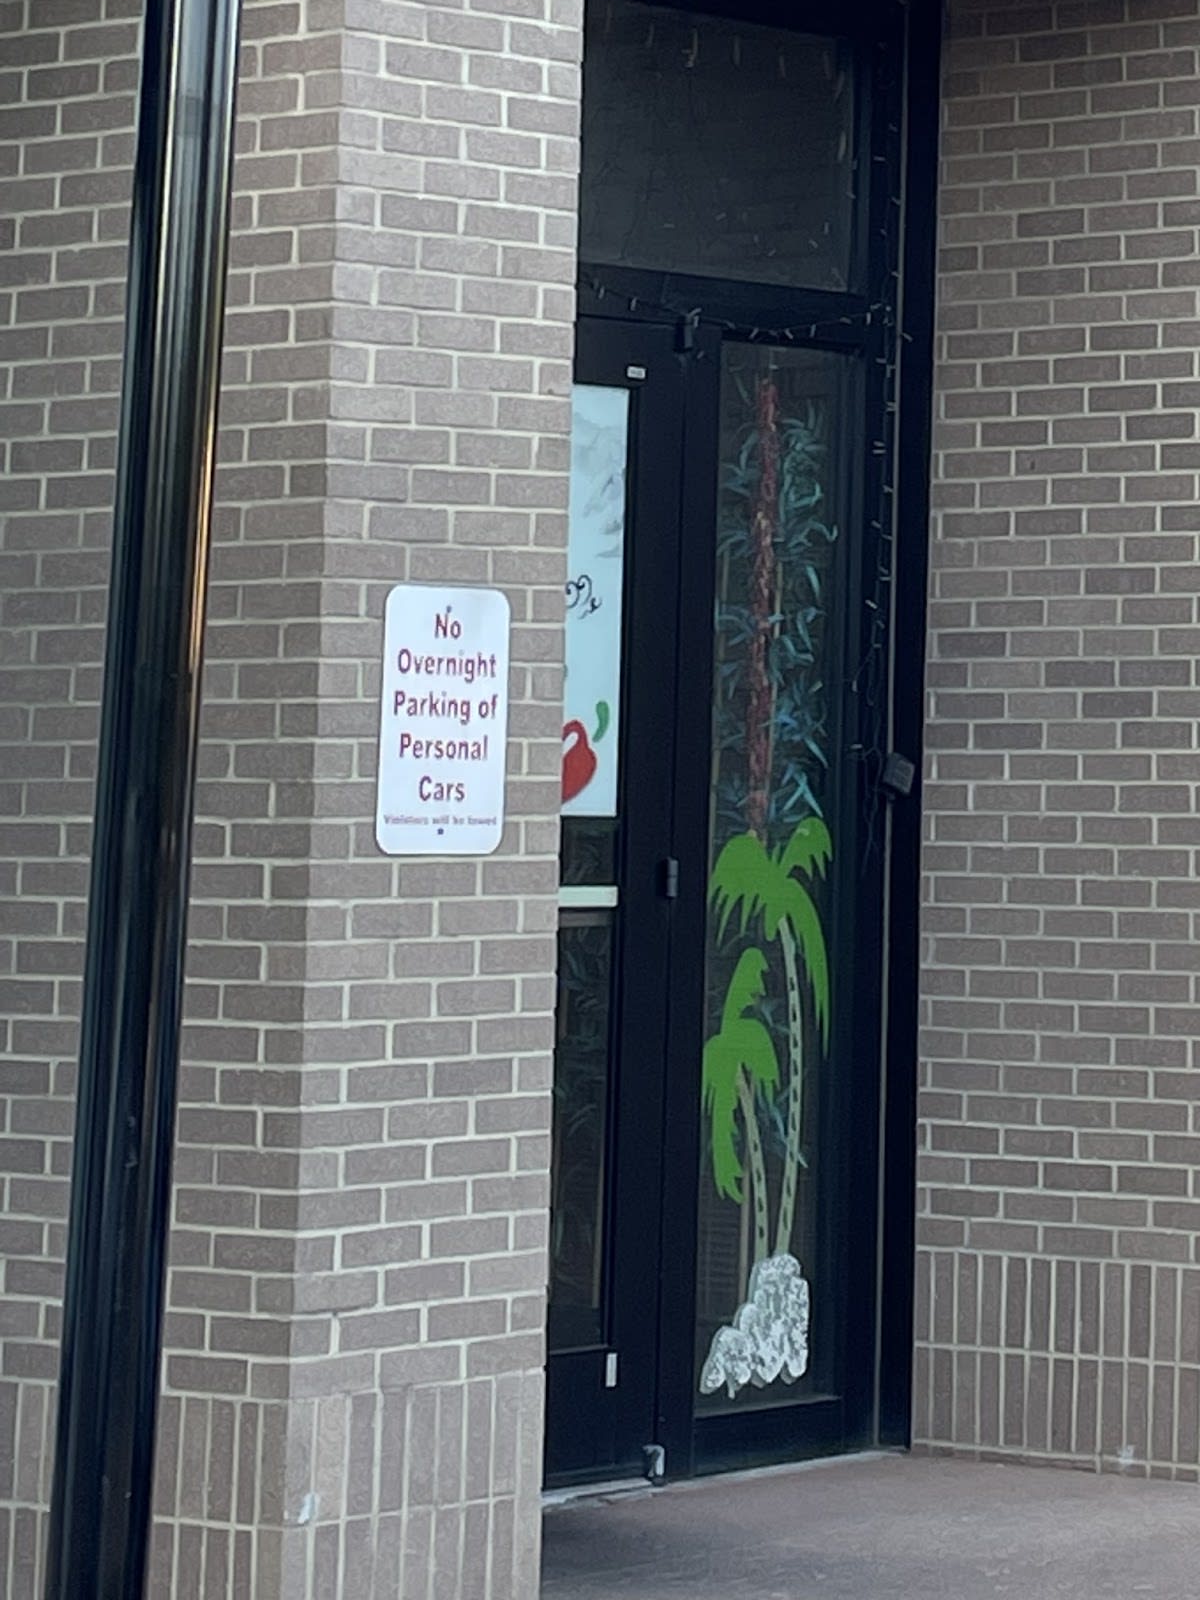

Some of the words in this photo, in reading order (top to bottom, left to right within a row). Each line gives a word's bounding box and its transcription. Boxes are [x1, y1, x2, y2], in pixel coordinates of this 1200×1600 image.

[434, 612, 462, 640] No
[397, 649, 497, 684] Overnight
[393, 690, 471, 725] Parking
[478, 693, 499, 719] of
[399, 733, 489, 761] Personal
[418, 775, 465, 802] Cars
